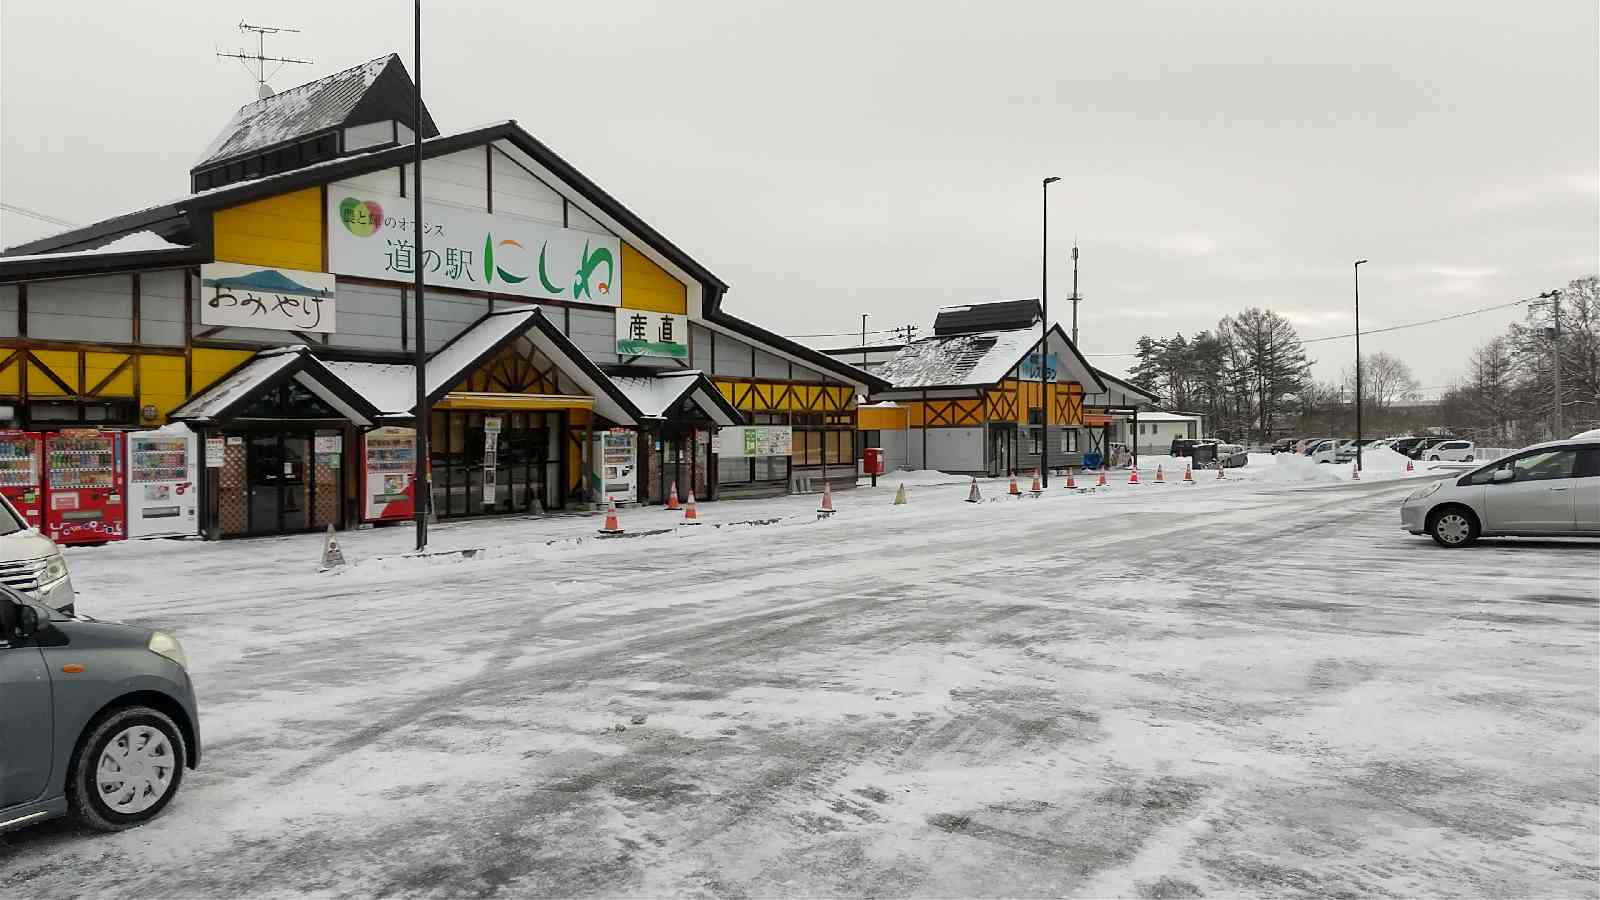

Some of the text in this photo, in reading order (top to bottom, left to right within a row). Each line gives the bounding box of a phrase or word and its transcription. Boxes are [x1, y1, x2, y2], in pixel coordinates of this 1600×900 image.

[384, 231, 614, 299] 道の駅 にしね
[208, 283, 328, 329] おみやげ
[630, 313, 677, 344] 産直
